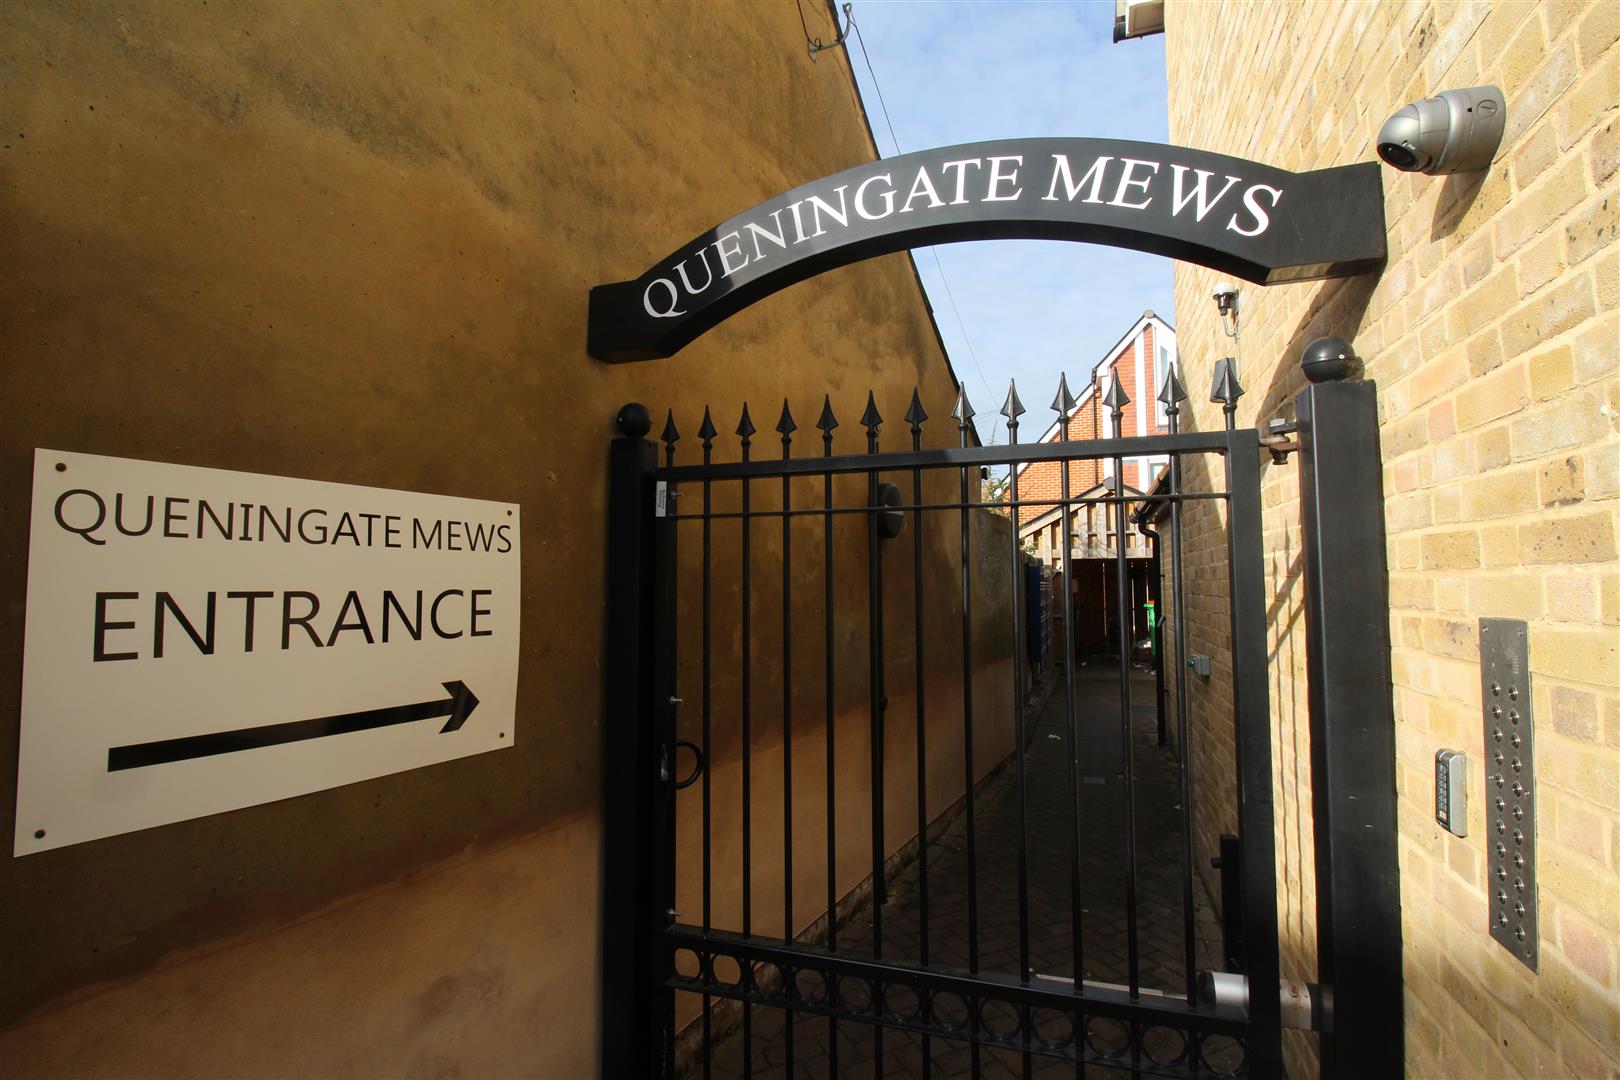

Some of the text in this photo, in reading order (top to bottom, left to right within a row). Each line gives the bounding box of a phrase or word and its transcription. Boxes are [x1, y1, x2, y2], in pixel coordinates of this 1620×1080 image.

[642, 153, 1283, 319] QUENINGATE MEWS
[54, 488, 513, 554] QUENINGATE MEWS
[92, 588, 494, 663] ENTRANCE
